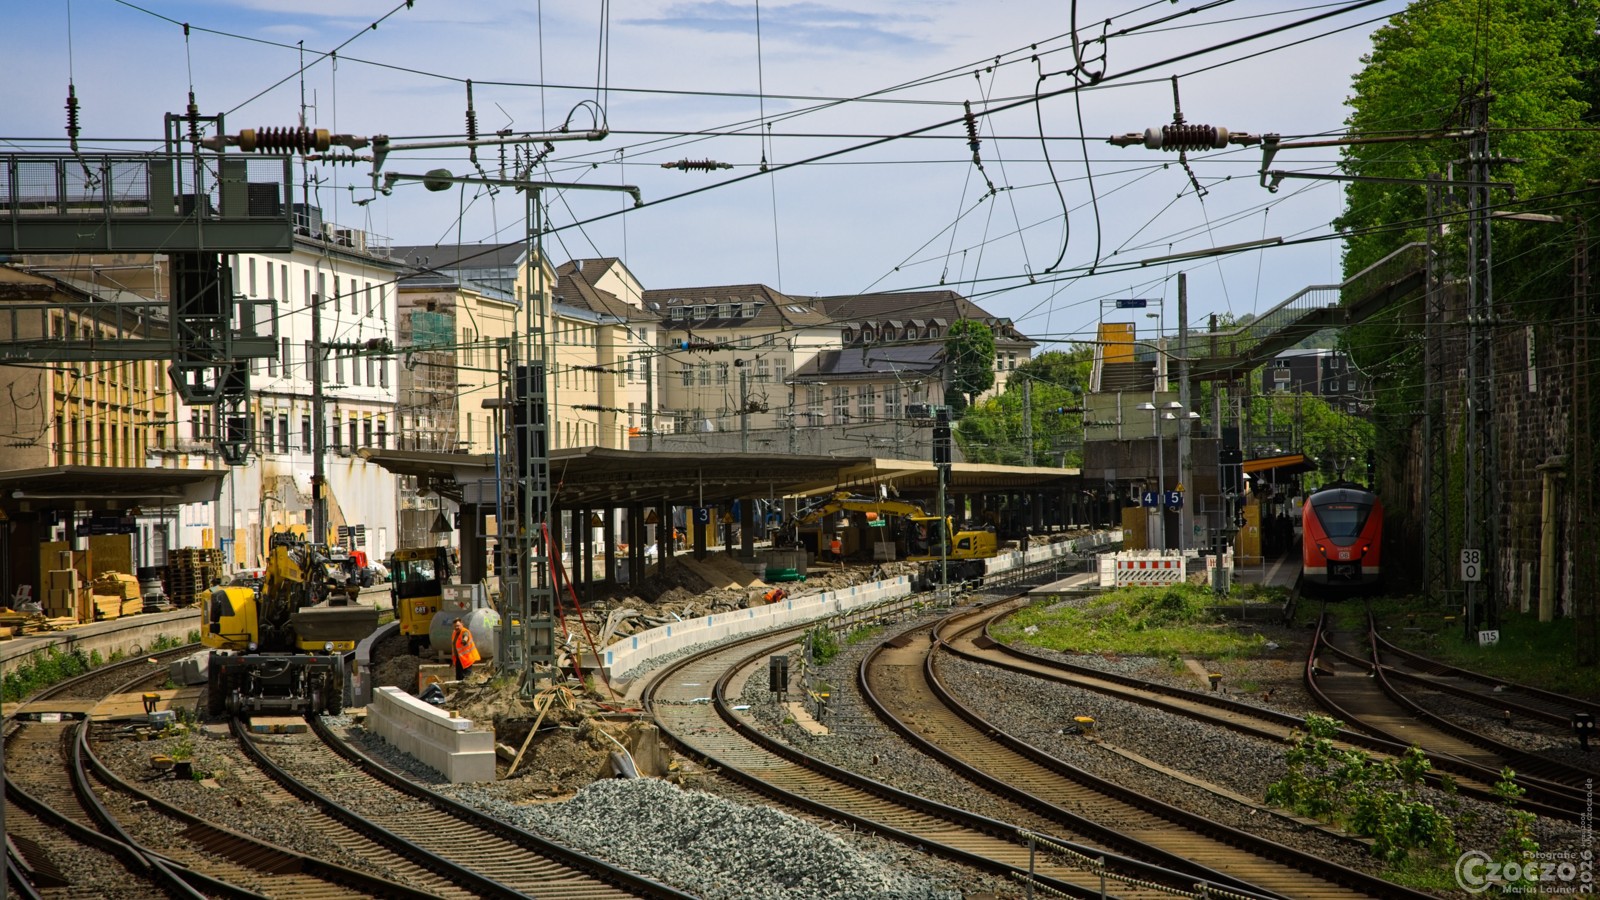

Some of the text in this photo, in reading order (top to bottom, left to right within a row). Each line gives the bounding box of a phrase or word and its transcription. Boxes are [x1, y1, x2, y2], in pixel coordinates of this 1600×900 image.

[1144, 492, 1152, 504] 4
[1171, 492, 1179, 504] 5
[700, 508, 708, 521] 3
[1462, 551, 1480, 564] 38
[1466, 565, 1476, 578] 0
[1482, 632, 1496, 641] 115
